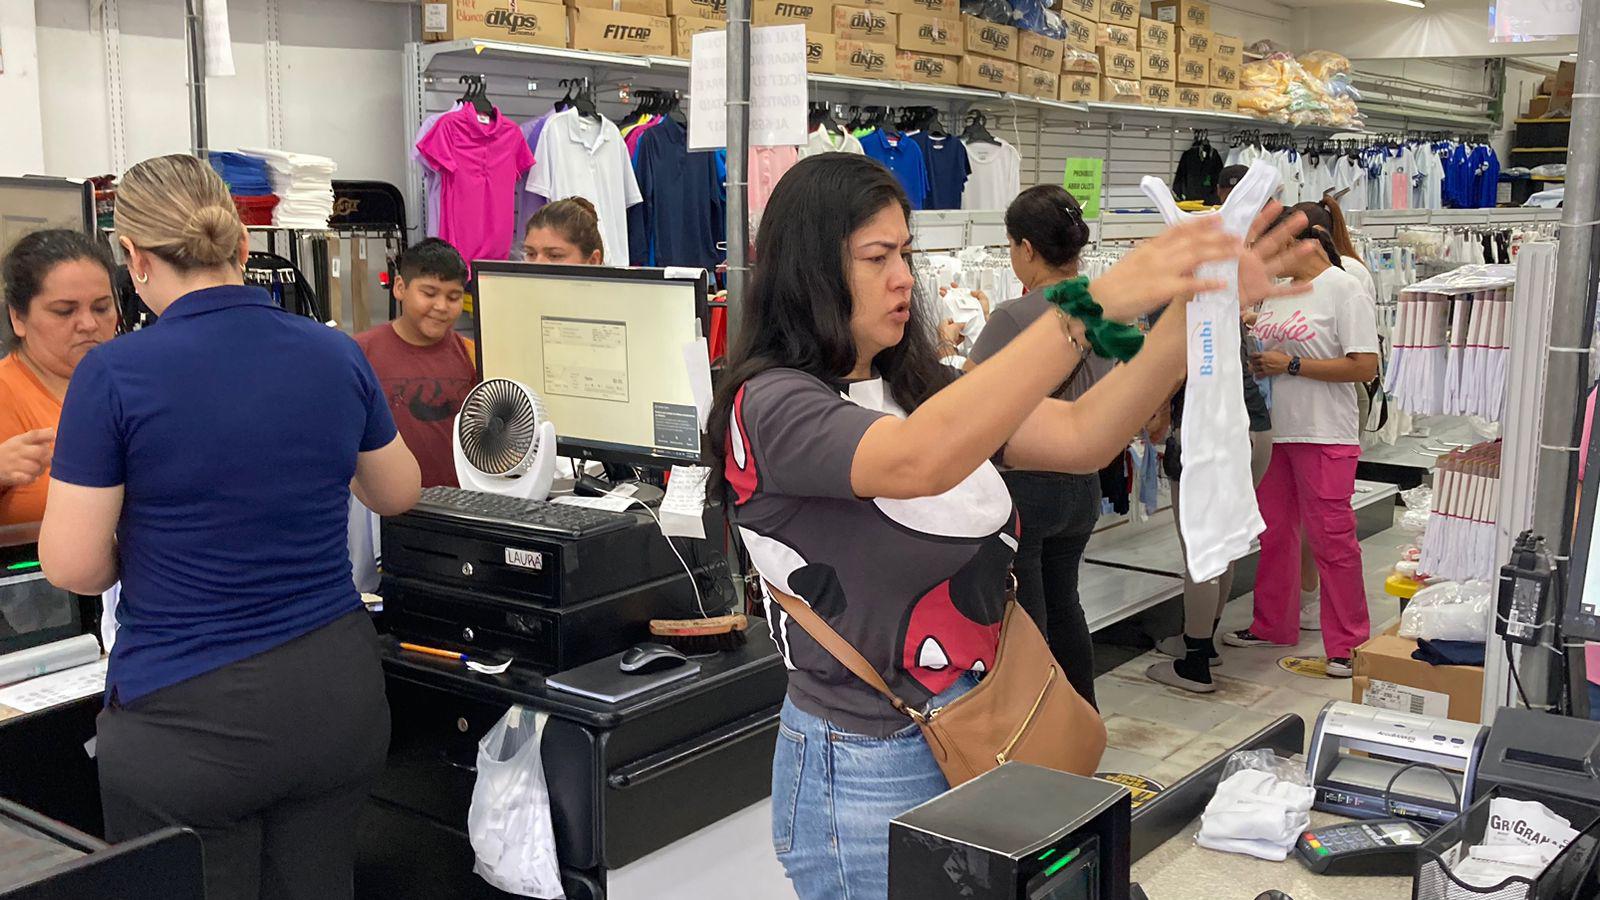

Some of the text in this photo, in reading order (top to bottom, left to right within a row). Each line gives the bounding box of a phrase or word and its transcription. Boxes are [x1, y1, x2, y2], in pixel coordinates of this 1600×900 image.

[775, 3, 813, 17] FITCAP
[484, 9, 537, 33] dkps
[604, 24, 651, 40] FITCAP
[1200, 320, 1214, 376] Bambi
[508, 550, 542, 568] LAURA
